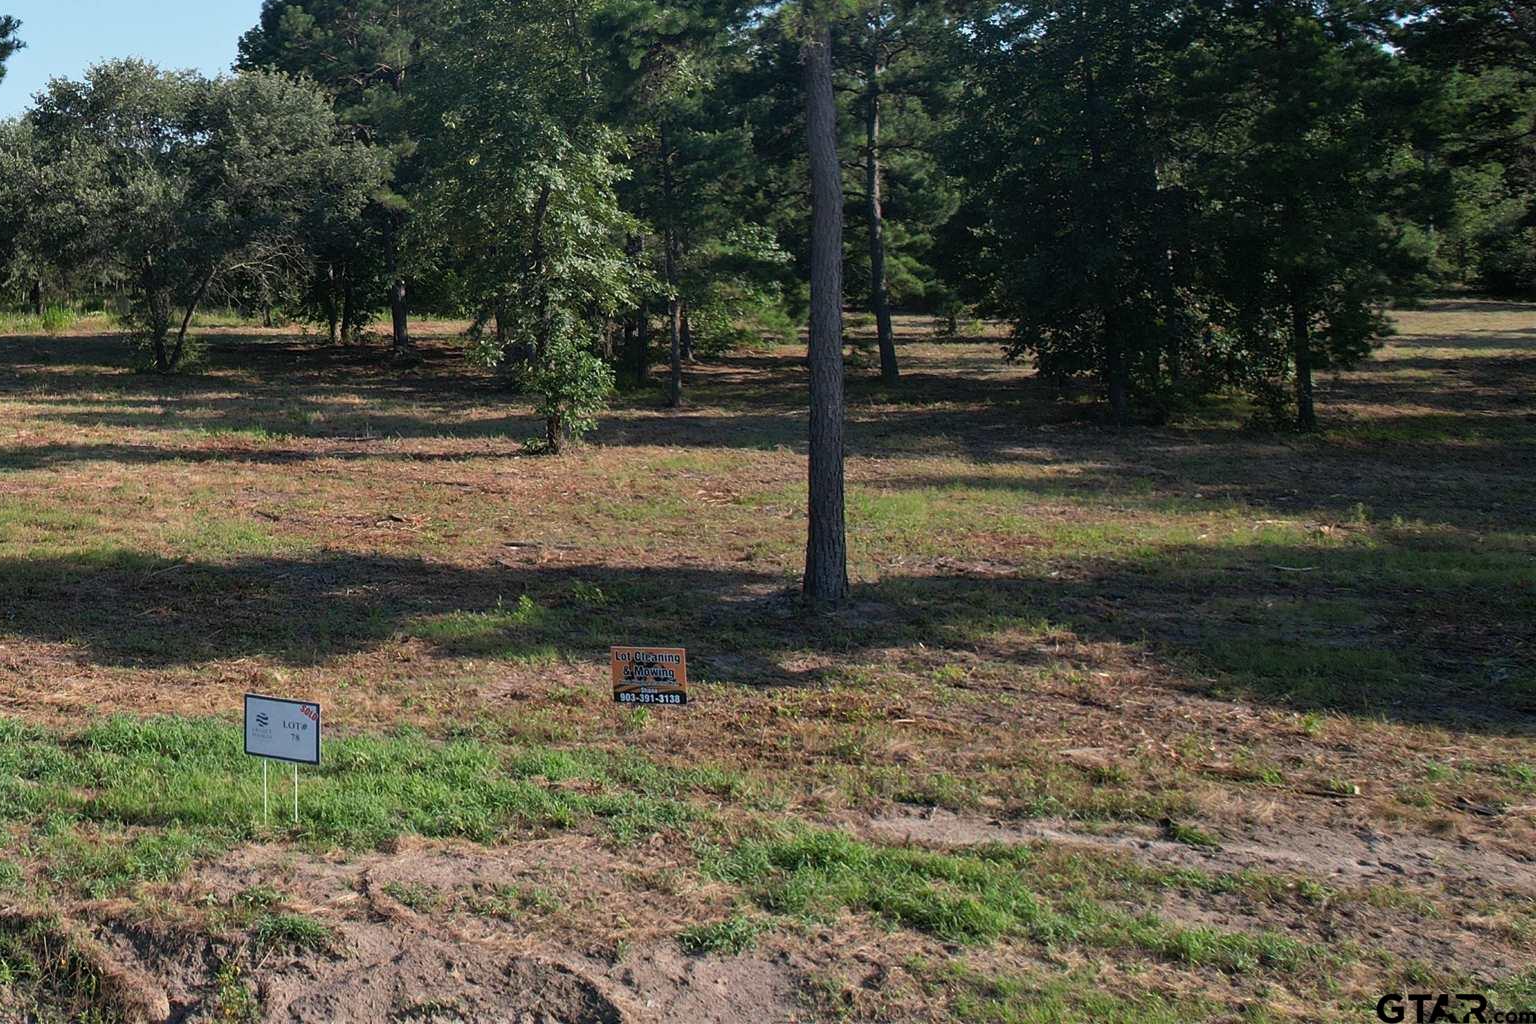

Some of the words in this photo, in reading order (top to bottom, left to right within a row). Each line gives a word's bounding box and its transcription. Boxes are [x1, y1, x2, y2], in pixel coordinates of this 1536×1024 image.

[615, 651, 630, 661] Lot
[624, 666, 632, 675] &
[634, 665, 674, 680] Mowing
[620, 693, 680, 703] 903-391-3138
[300, 704, 318, 721] SOLD
[283, 720, 308, 731] LOT#
